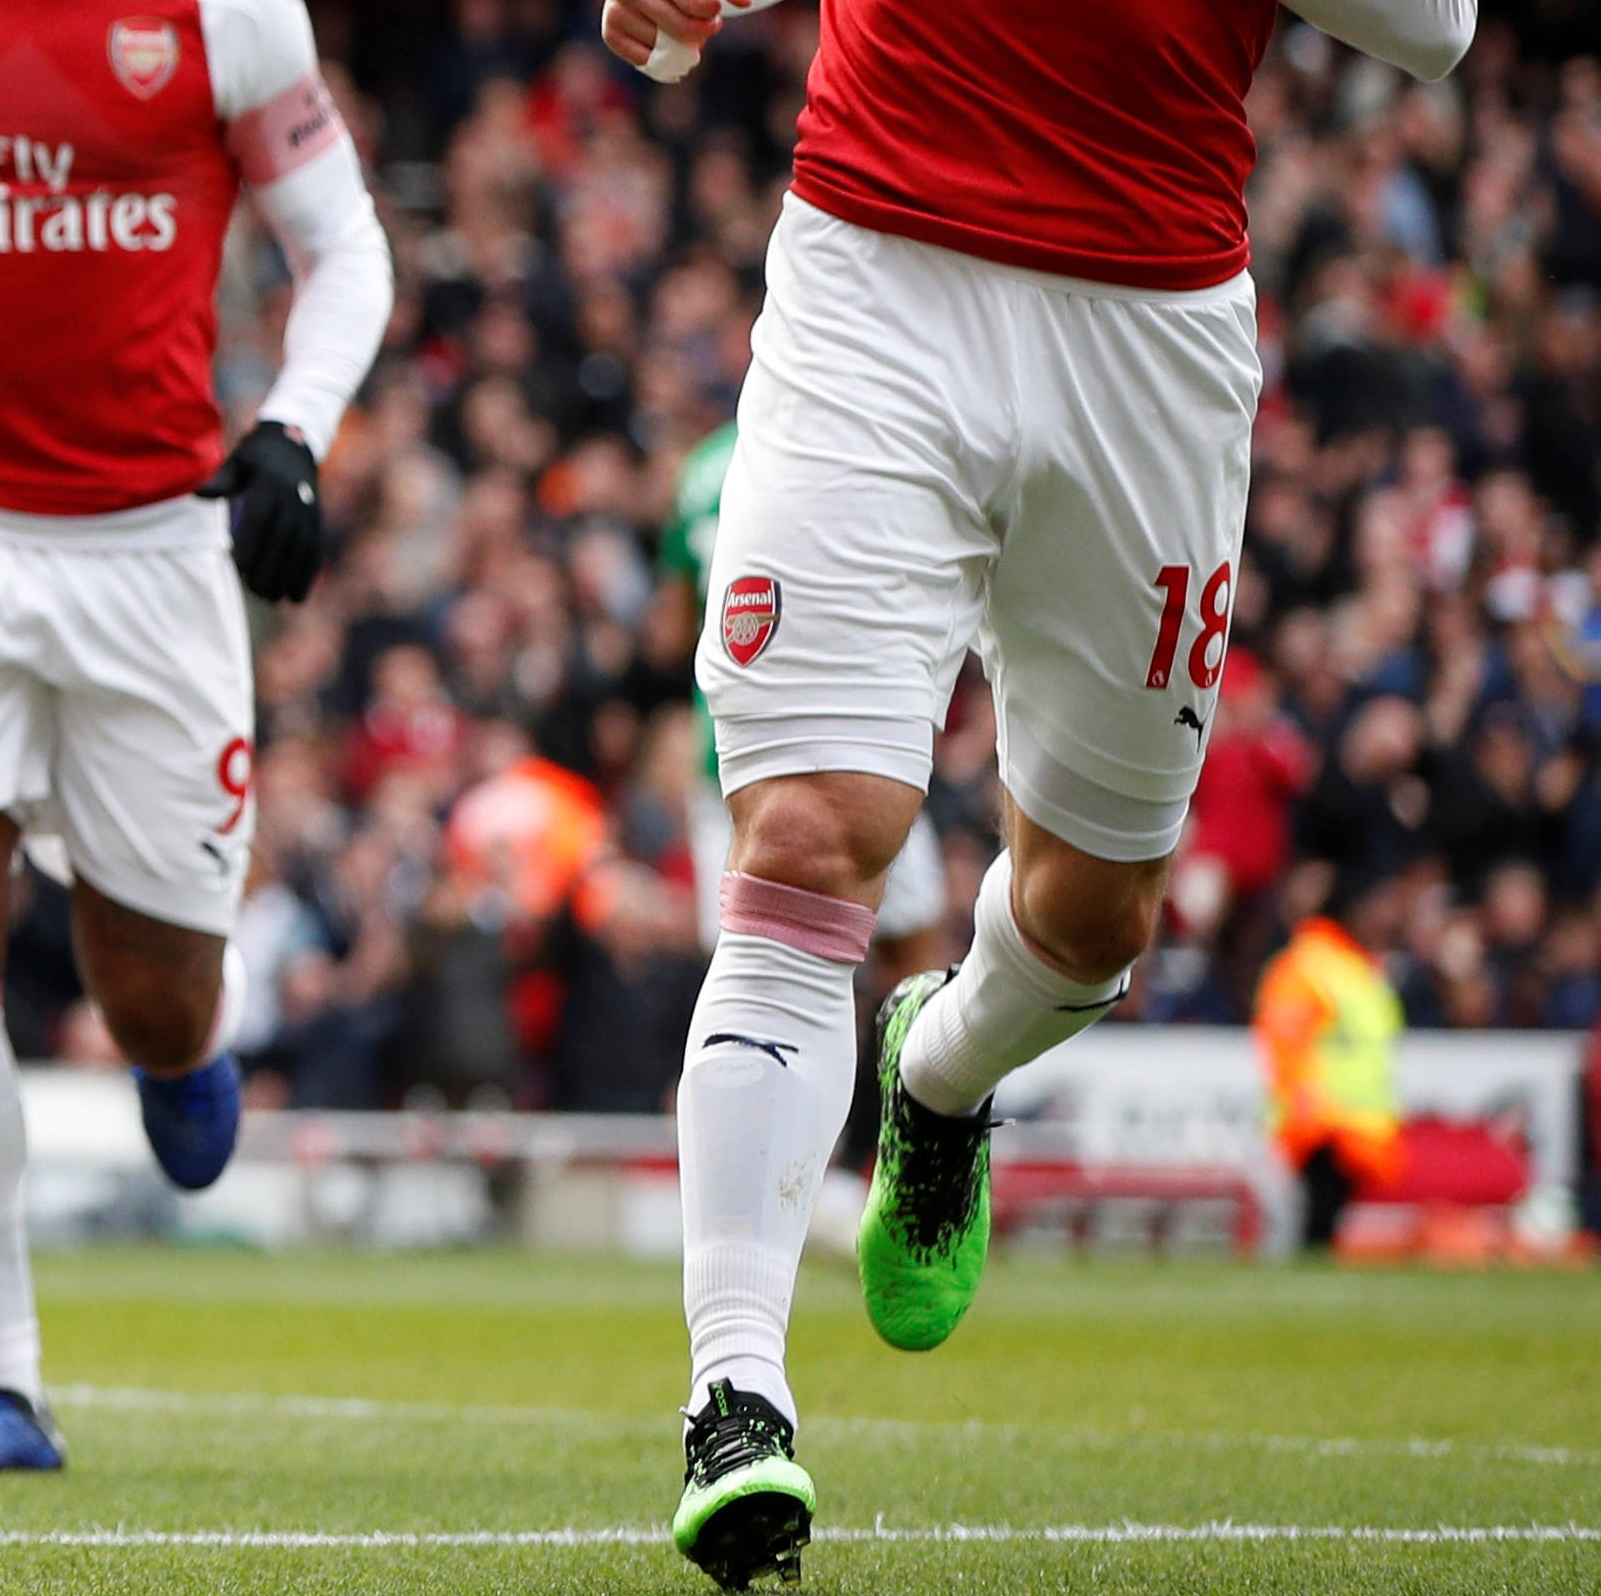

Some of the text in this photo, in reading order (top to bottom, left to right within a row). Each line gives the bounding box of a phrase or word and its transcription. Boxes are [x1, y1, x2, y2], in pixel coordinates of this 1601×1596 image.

[727, 588, 772, 608] Arsenal
[1145, 559, 1231, 689] 18
[216, 735, 256, 835] 9
